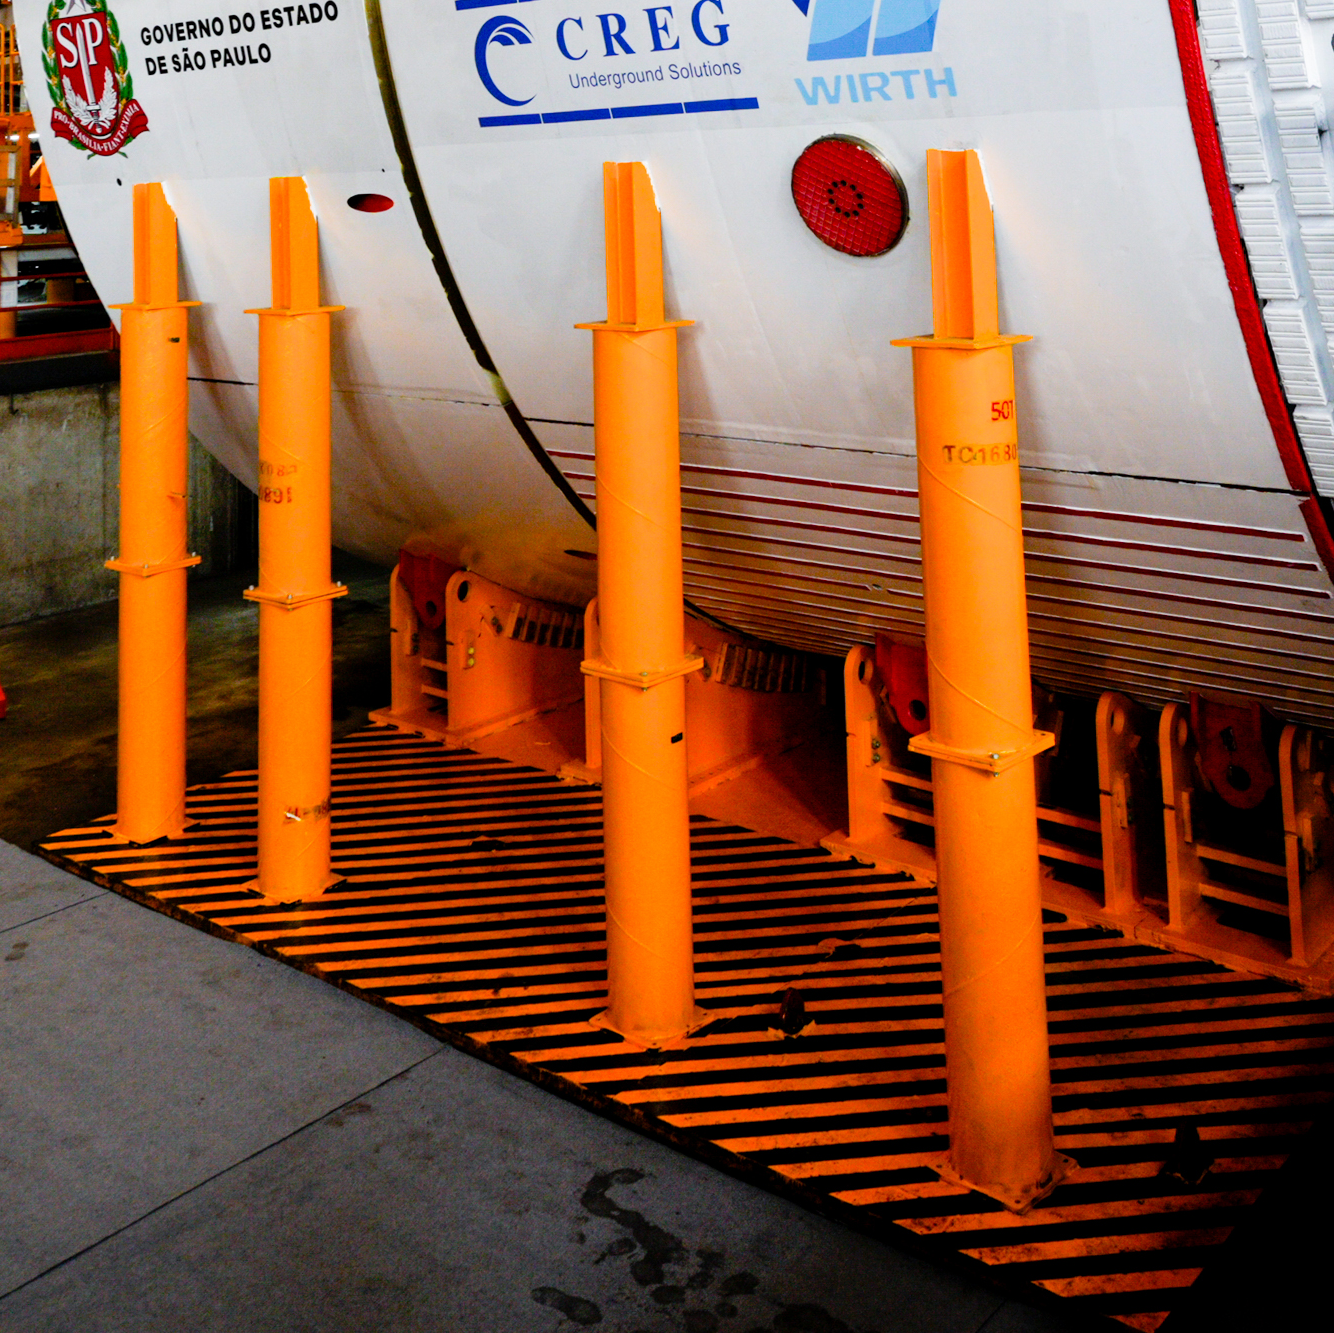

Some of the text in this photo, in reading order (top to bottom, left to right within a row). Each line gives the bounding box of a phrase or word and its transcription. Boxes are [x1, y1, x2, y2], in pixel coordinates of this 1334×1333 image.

[140, 0, 339, 46] GOVERNO DO ESTADO
[146, 43, 271, 76] DE SÃO PAULO
[569, 59, 742, 90] Underground Solutions
[793, 66, 958, 107] WIRTH
